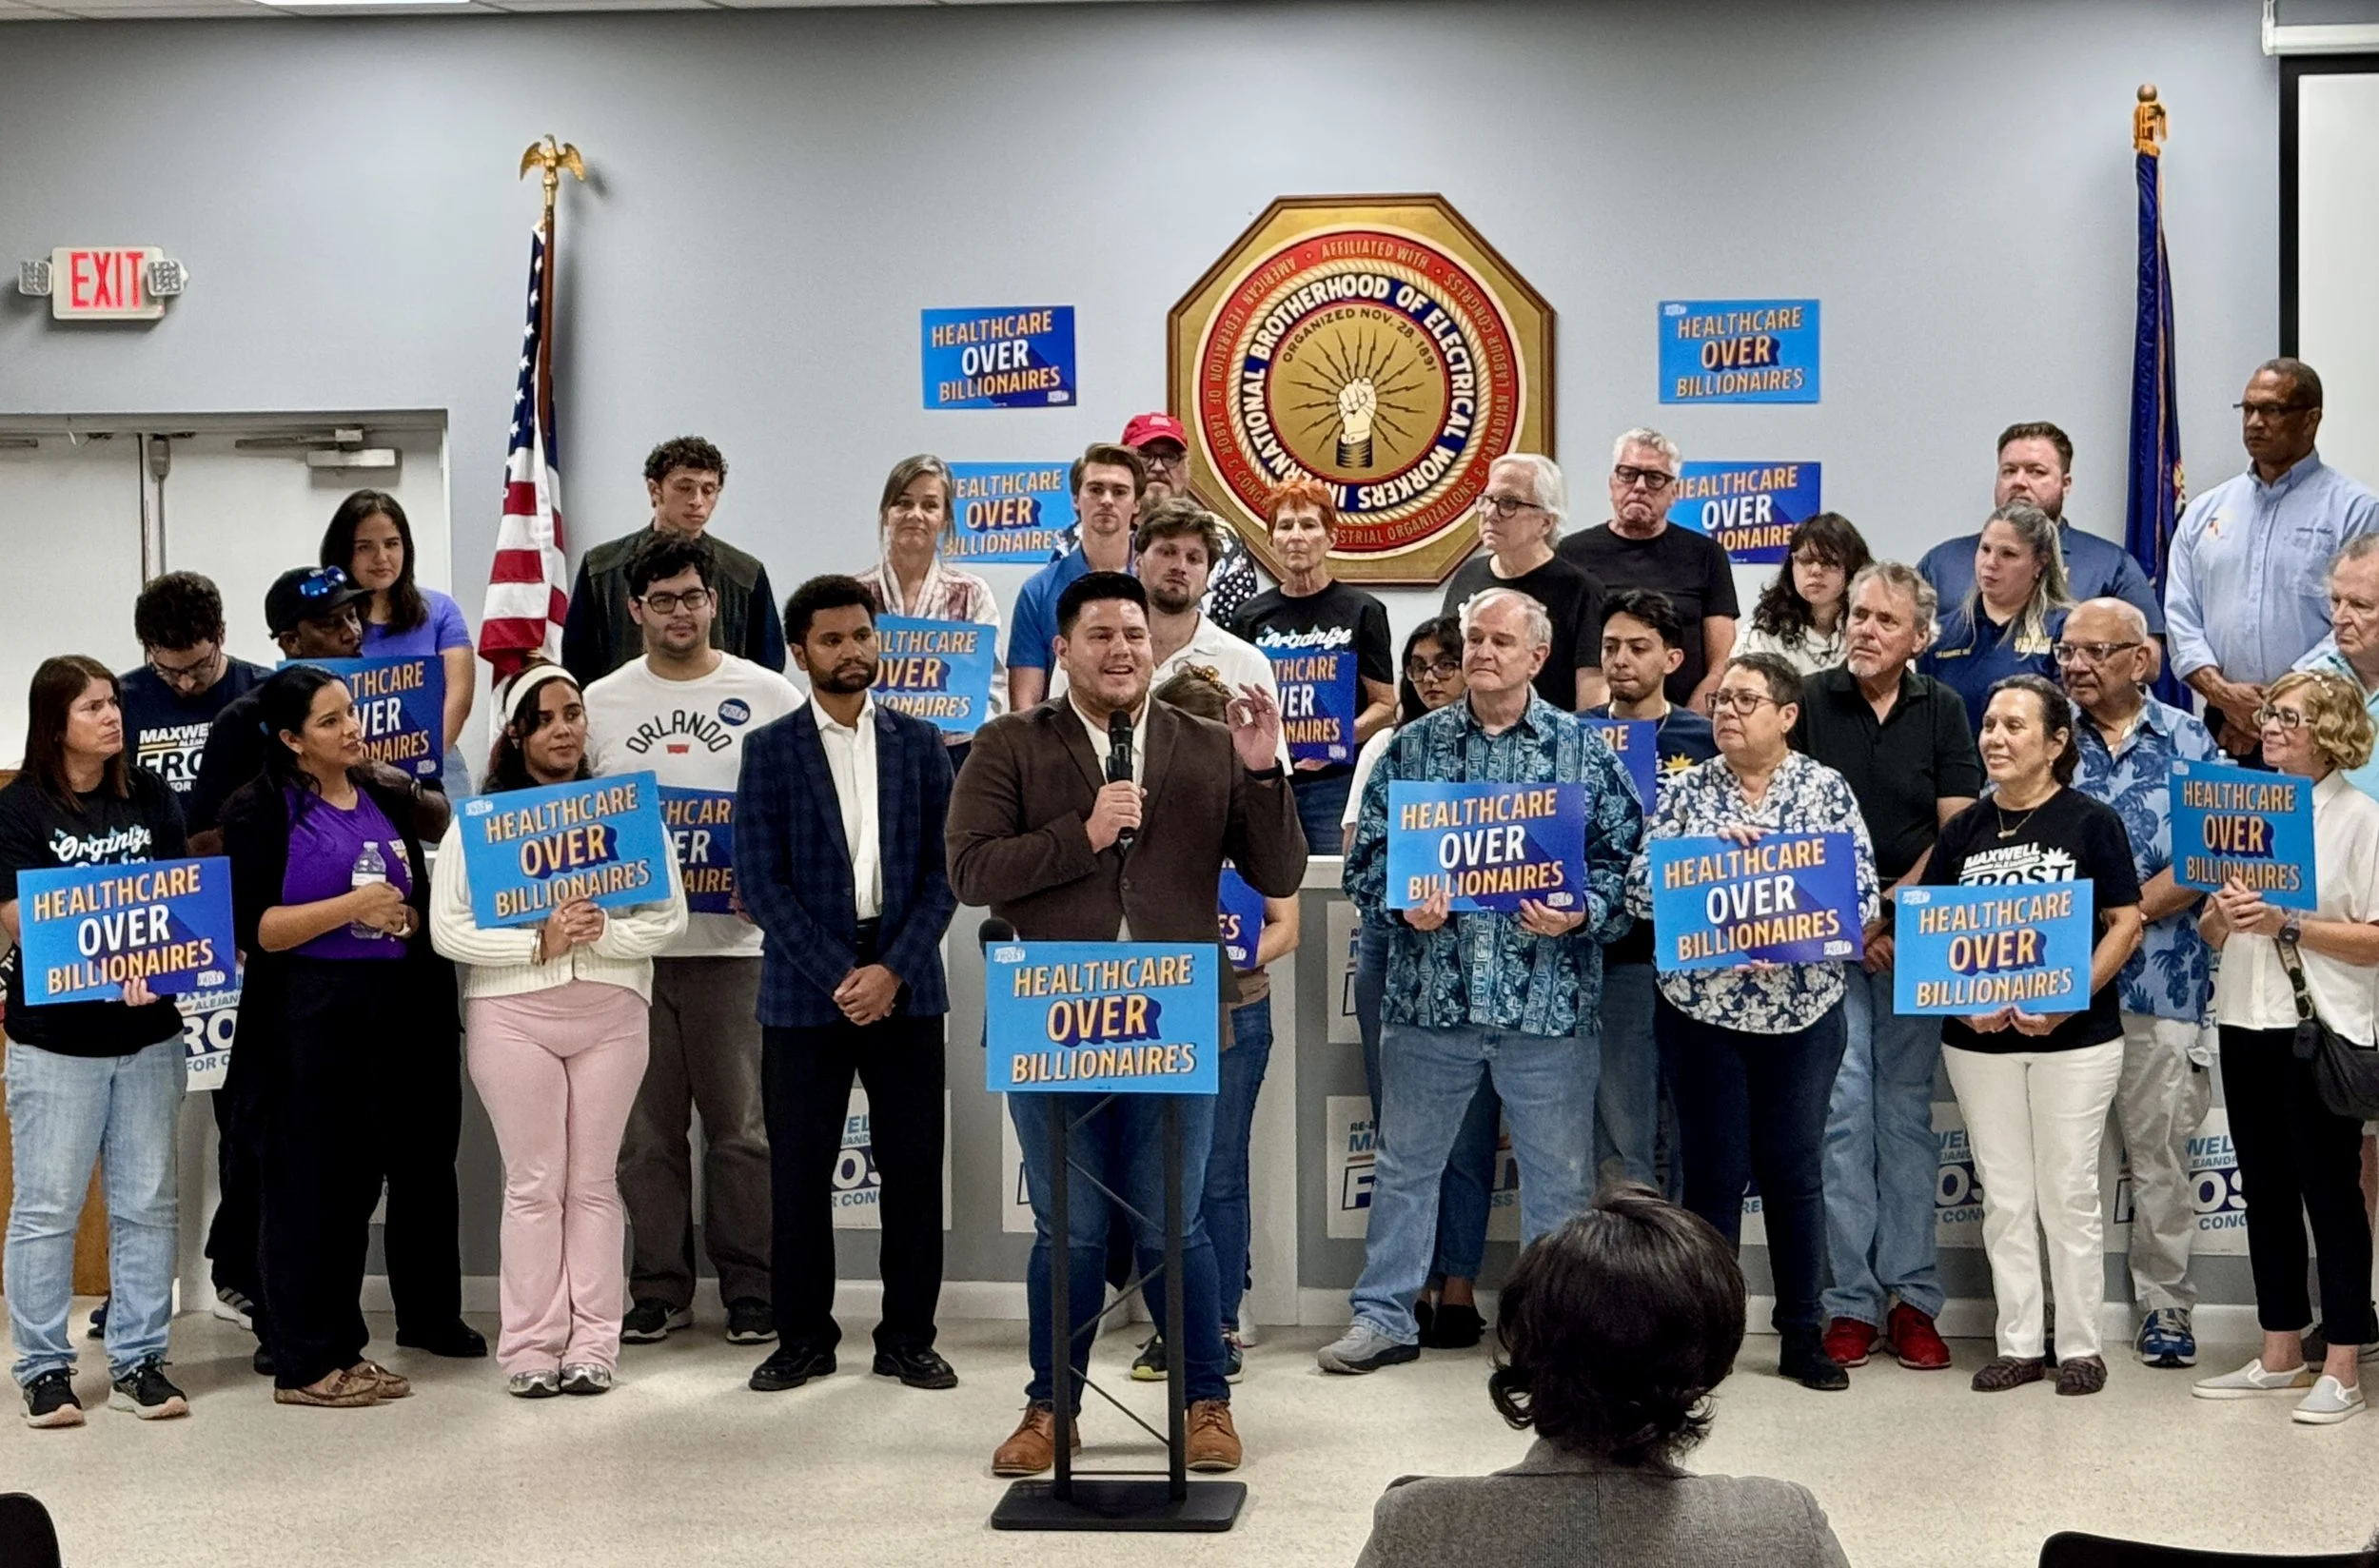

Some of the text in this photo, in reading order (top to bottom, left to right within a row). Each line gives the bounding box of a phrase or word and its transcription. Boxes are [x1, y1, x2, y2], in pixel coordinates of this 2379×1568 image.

[1321, 240, 1430, 270] AFFILIATED WITH
[69, 251, 145, 308] EXIT
[1241, 255, 1297, 305] AMERICAN
[1395, 284, 1428, 314] OF
[1248, 273, 1390, 362] BROTHERHOOD
[1444, 272, 1498, 334] CONGRESS
[1677, 305, 1802, 340] HEALTHCARE
[932, 310, 1052, 347] HEALTHCARE
[1209, 306, 1246, 382] FEDERATION
[1282, 307, 1355, 363] ORGANIZED
[1360, 307, 1394, 327] NOV.
[1415, 340, 1438, 372] 1891
[961, 338, 1030, 377] OVER
[1423, 307, 1475, 439] ELECTRICAL
[1487, 335, 1510, 387] LABOUR
[1701, 334, 1772, 370] OVER
[938, 365, 1061, 402] BILLIONAIRES
[1208, 389, 1223, 405] OF
[1676, 367, 1804, 398] BILLIONAIRES
[1209, 413, 1233, 456] LABOR
[1484, 395, 1510, 462] CANADIAN
[953, 469, 1062, 499] EALTHCARE
[1234, 470, 1270, 509] CONGR
[1356, 444, 1457, 509] WORKERS
[965, 496, 1034, 530] OVER
[1386, 480, 1477, 540] ORGANIZATIONS
[1701, 494, 1773, 531] OVER
[350, 660, 424, 699] THCARE
[1275, 655, 1339, 682] THCARE
[139, 721, 213, 744] MAXWE
[353, 696, 402, 740] VER
[625, 709, 733, 755] ORLANDO
[1286, 716, 1341, 744] NAIRES
[485, 783, 639, 845] HEALTHCARE
[1401, 788, 1558, 831] HEALTHCARE
[2183, 780, 2296, 813] HEALTHCARE
[49, 824, 152, 862] Organize
[520, 823, 610, 877] OVER
[1438, 824, 1525, 870] OVER
[2202, 813, 2266, 853] OVER
[1664, 837, 1826, 890] HEALTHCARE
[1963, 841, 2041, 870] MAXWELL
[33, 864, 202, 922] HEALTHCARE
[495, 859, 651, 917] BILLIONAIRES
[1705, 874, 1797, 925] OVER
[78, 904, 170, 957] OVER
[1919, 890, 2074, 934] HEALTHCARE
[1677, 909, 1840, 962] BILLIONAIRES
[1948, 927, 2038, 972] OVER
[48, 938, 214, 995] BILLIONAIRES
[1013, 953, 1195, 997] HEALTHCARE
[1917, 967, 2074, 1008] BILLIONAIRES
[1047, 993, 1150, 1044] OVER
[1012, 1044, 1196, 1084] BILLIONAIRES
